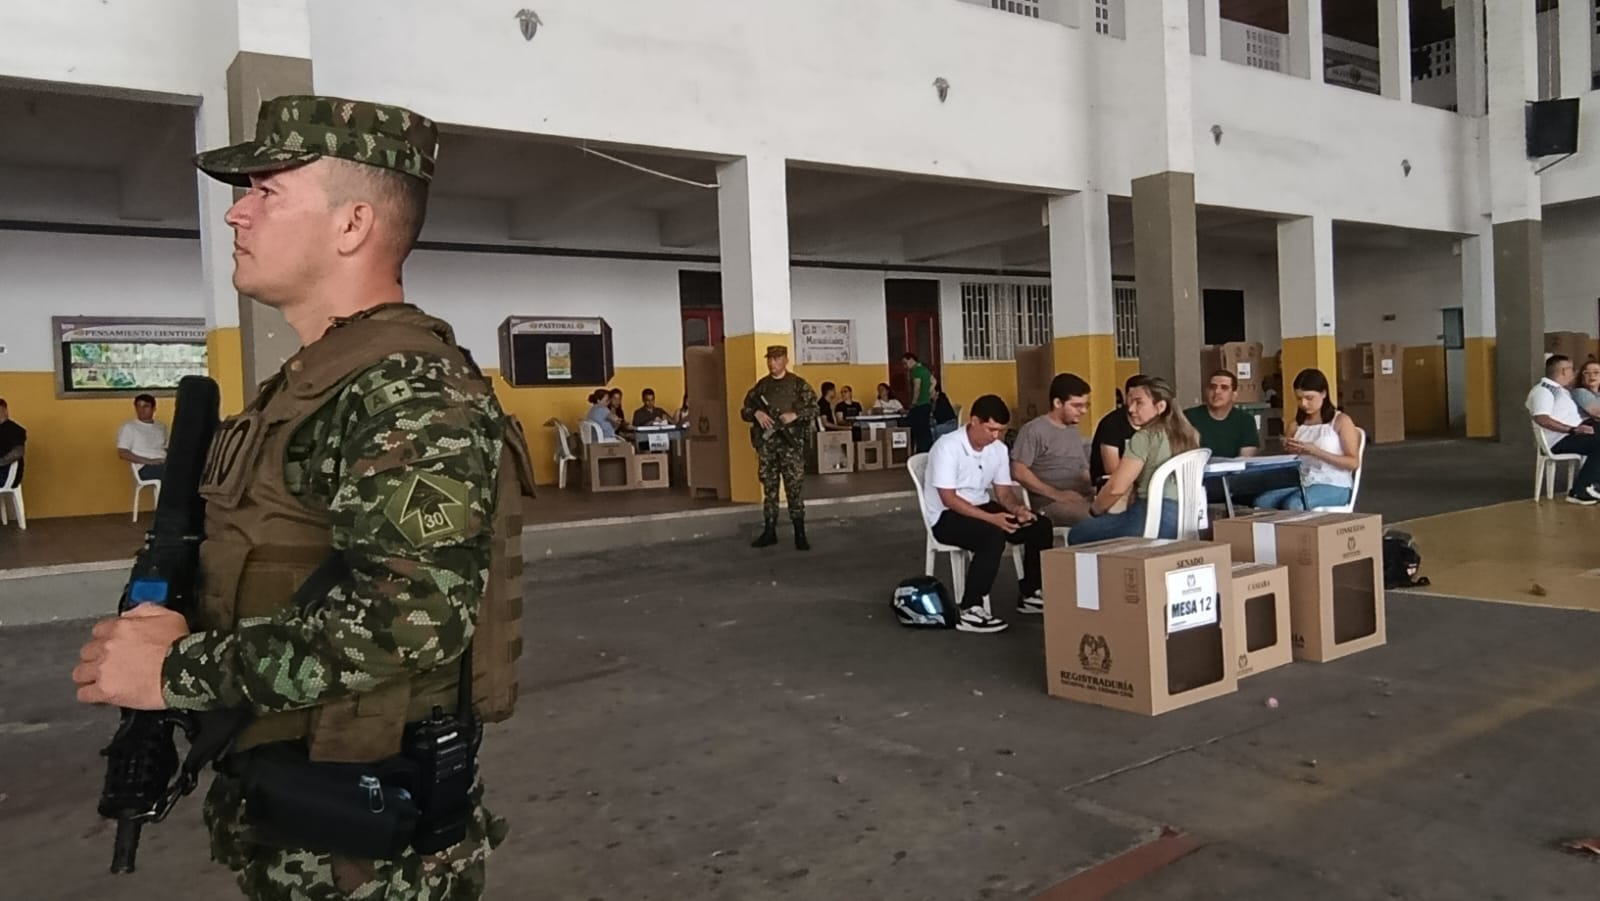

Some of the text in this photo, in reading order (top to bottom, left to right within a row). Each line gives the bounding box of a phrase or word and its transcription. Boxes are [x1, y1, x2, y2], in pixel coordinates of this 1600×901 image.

[85, 328, 151, 337] PENSAMIENTO
[424, 512, 444, 528] 30
[1176, 557, 1204, 569] SENADO
[1171, 596, 1212, 618] MESA 12
[1060, 671, 1134, 692] REGISTRADURÍA
